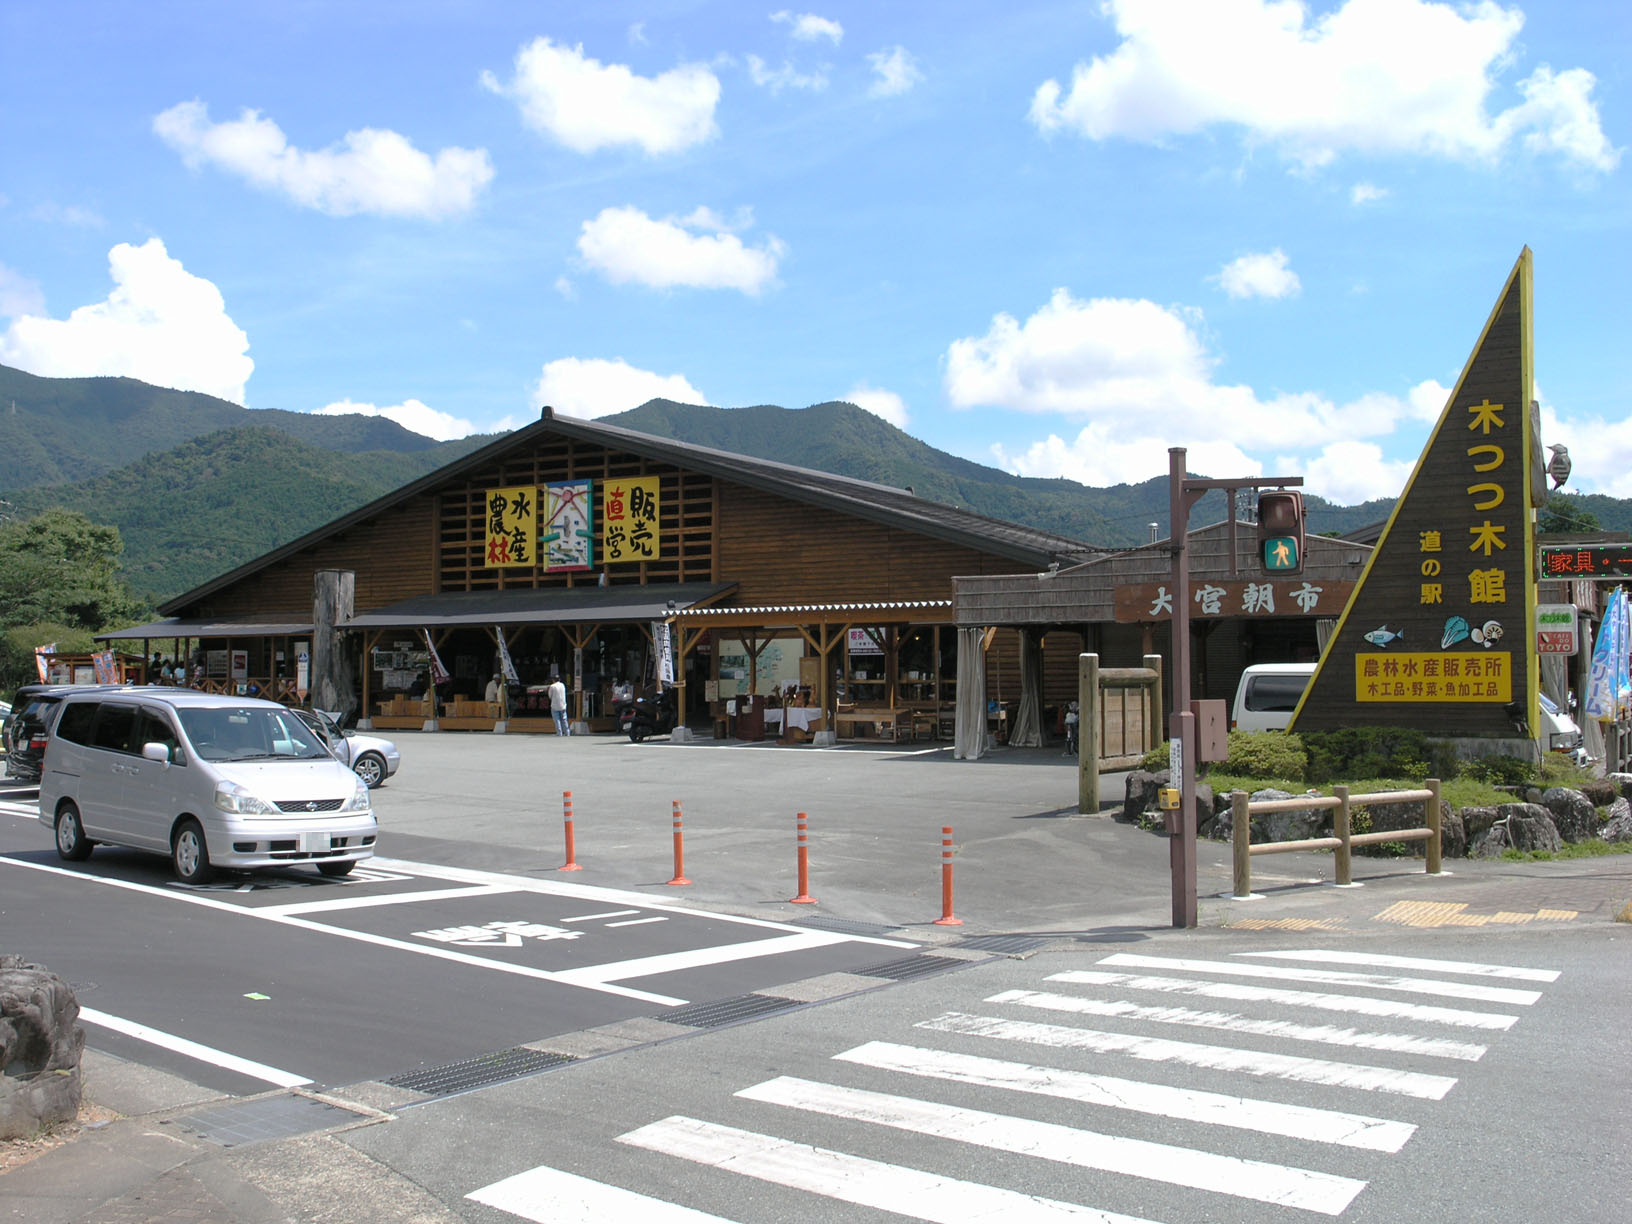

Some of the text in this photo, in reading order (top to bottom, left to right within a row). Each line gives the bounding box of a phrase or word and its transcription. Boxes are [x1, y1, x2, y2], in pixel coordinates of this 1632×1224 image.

[488, 493, 512, 564] 農林
[509, 492, 531, 563] 水産
[606, 486, 626, 559] 直営
[630, 486, 656, 557] 販売
[1467, 399, 1506, 604] 木つつ木館
[1149, 582, 1324, 616] 大宮朝市
[1419, 531, 1442, 605] 道の駅
[1363, 657, 1503, 678] 農林水産販売所
[1367, 681, 1499, 697] 木工品・野菜・魚加工品
